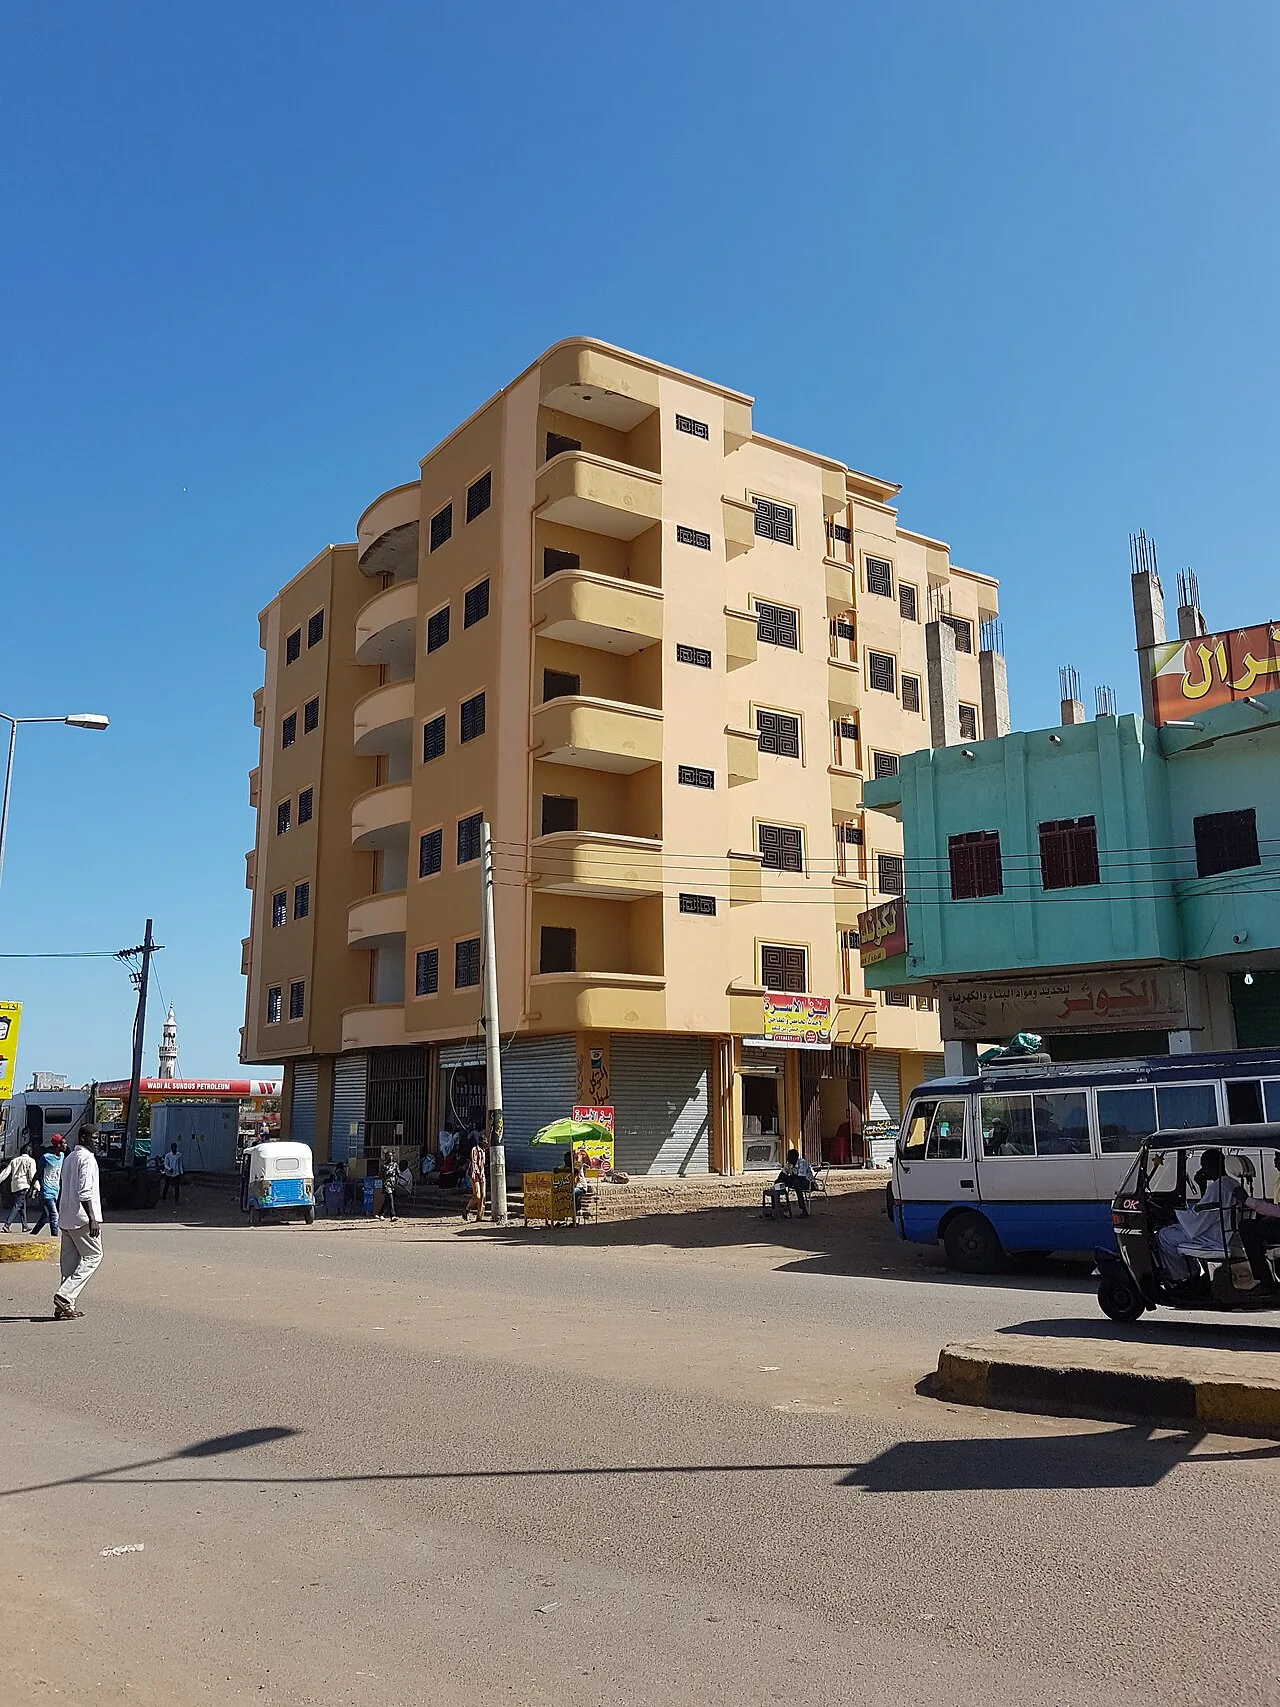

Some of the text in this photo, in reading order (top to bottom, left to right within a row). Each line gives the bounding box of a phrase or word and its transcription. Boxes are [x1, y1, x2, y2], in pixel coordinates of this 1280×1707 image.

[948, 984, 1070, 1004] للحديد ومواد البناء والكهرباء
[1056, 978, 1159, 1019] الكوثر
[147, 1082, 230, 1091] WADI AL SUNDUS PETROLEUM
[1123, 1199, 1140, 1210] OK
